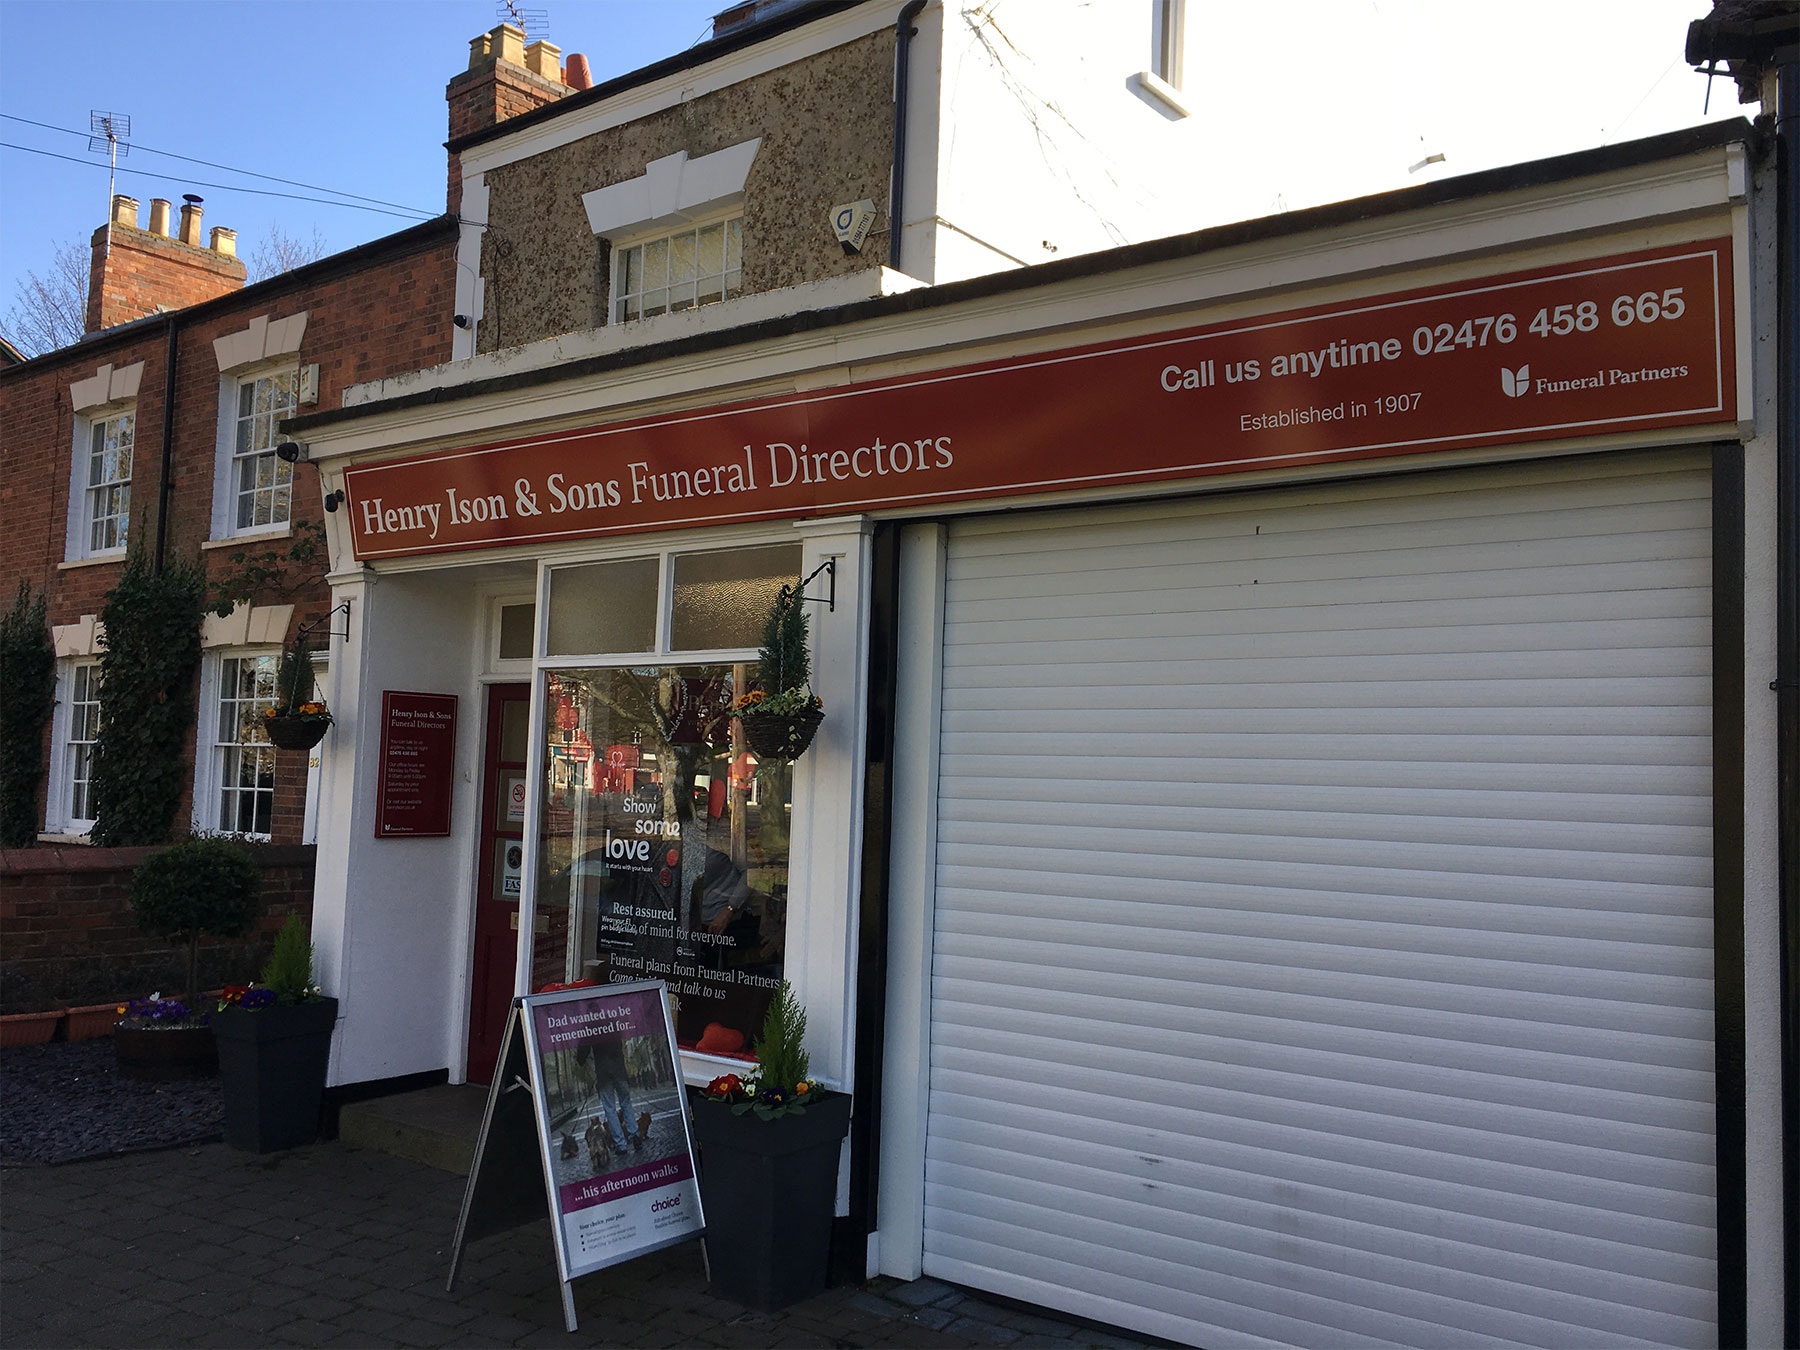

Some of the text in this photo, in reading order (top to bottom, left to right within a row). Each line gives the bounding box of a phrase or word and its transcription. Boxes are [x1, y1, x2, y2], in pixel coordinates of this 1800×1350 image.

[1160, 287, 1686, 393] Call us anytime 02476 458 665
[1535, 362, 1689, 396] Funeral Partners
[1239, 392, 1423, 433] Established in 1907
[361, 435, 954, 539] Henry Ison & Sons Funeral Directors
[391, 709, 413, 719] Henry
[414, 710, 428, 719] Ison
[436, 712, 452, 720] Sons
[391, 719, 446, 729] Funeral Directors
[623, 797, 656, 814] Show
[635, 819, 680, 836] some
[605, 829, 650, 861] love
[613, 902, 677, 921] Rest assured.
[638, 922, 649, 935] of
[649, 924, 674, 938] mind
[676, 926, 690, 940] for
[691, 932, 737, 947] everyone.
[610, 952, 644, 970] Funeral
[645, 957, 671, 974] plans
[673, 959, 695, 977] from
[697, 965, 735, 983] Funeral
[737, 971, 780, 990] Partners
[609, 970, 634, 983] Come
[683, 981, 701, 996] talk
[702, 983, 713, 998] to
[714, 988, 726, 1000] us
[547, 1005, 632, 1029] Dad wanted to be
[550, 1020, 636, 1044] remembered for...
[600, 1173, 650, 1196] afternoon
[651, 1163, 679, 1181] walks
[651, 1193, 682, 1213] choice
